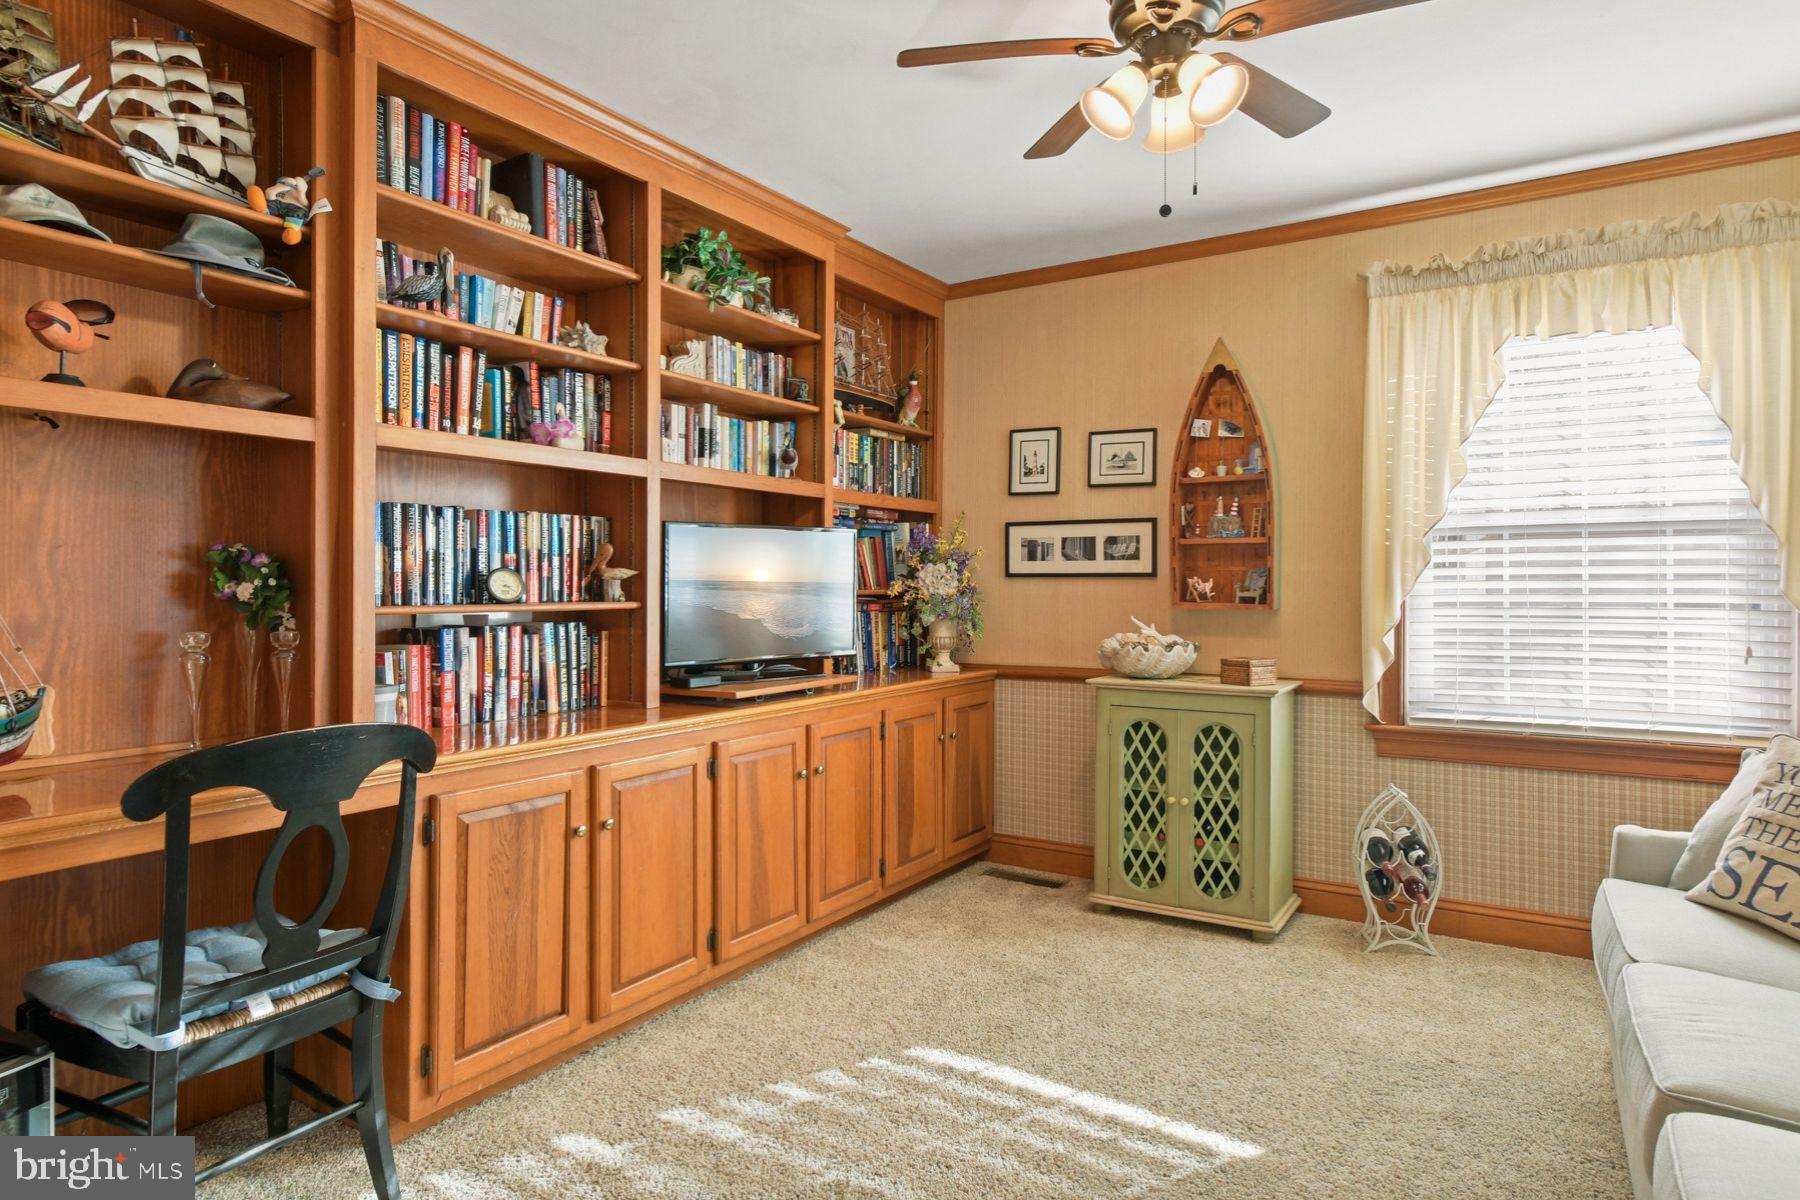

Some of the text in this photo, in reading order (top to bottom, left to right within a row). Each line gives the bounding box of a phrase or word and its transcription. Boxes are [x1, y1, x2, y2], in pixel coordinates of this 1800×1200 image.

[437, 138, 445, 169] SANDFORD
[461, 136, 470, 156] JANET
[448, 153, 459, 193] EVANOVICH
[460, 156, 469, 193] EVANOVICH
[567, 174, 575, 196] VINCE
[387, 334, 396, 360] JAMES
[478, 352, 486, 374] JAMES
[388, 360, 397, 409] PATTERSON
[402, 337, 411, 411] JAMES PATTERSON
[416, 341, 425, 413] JAMES PATTERSON
[475, 374, 485, 412] PATTERSON
[1741, 816, 1800, 854] THE
[1707, 846, 1800, 928] SE
